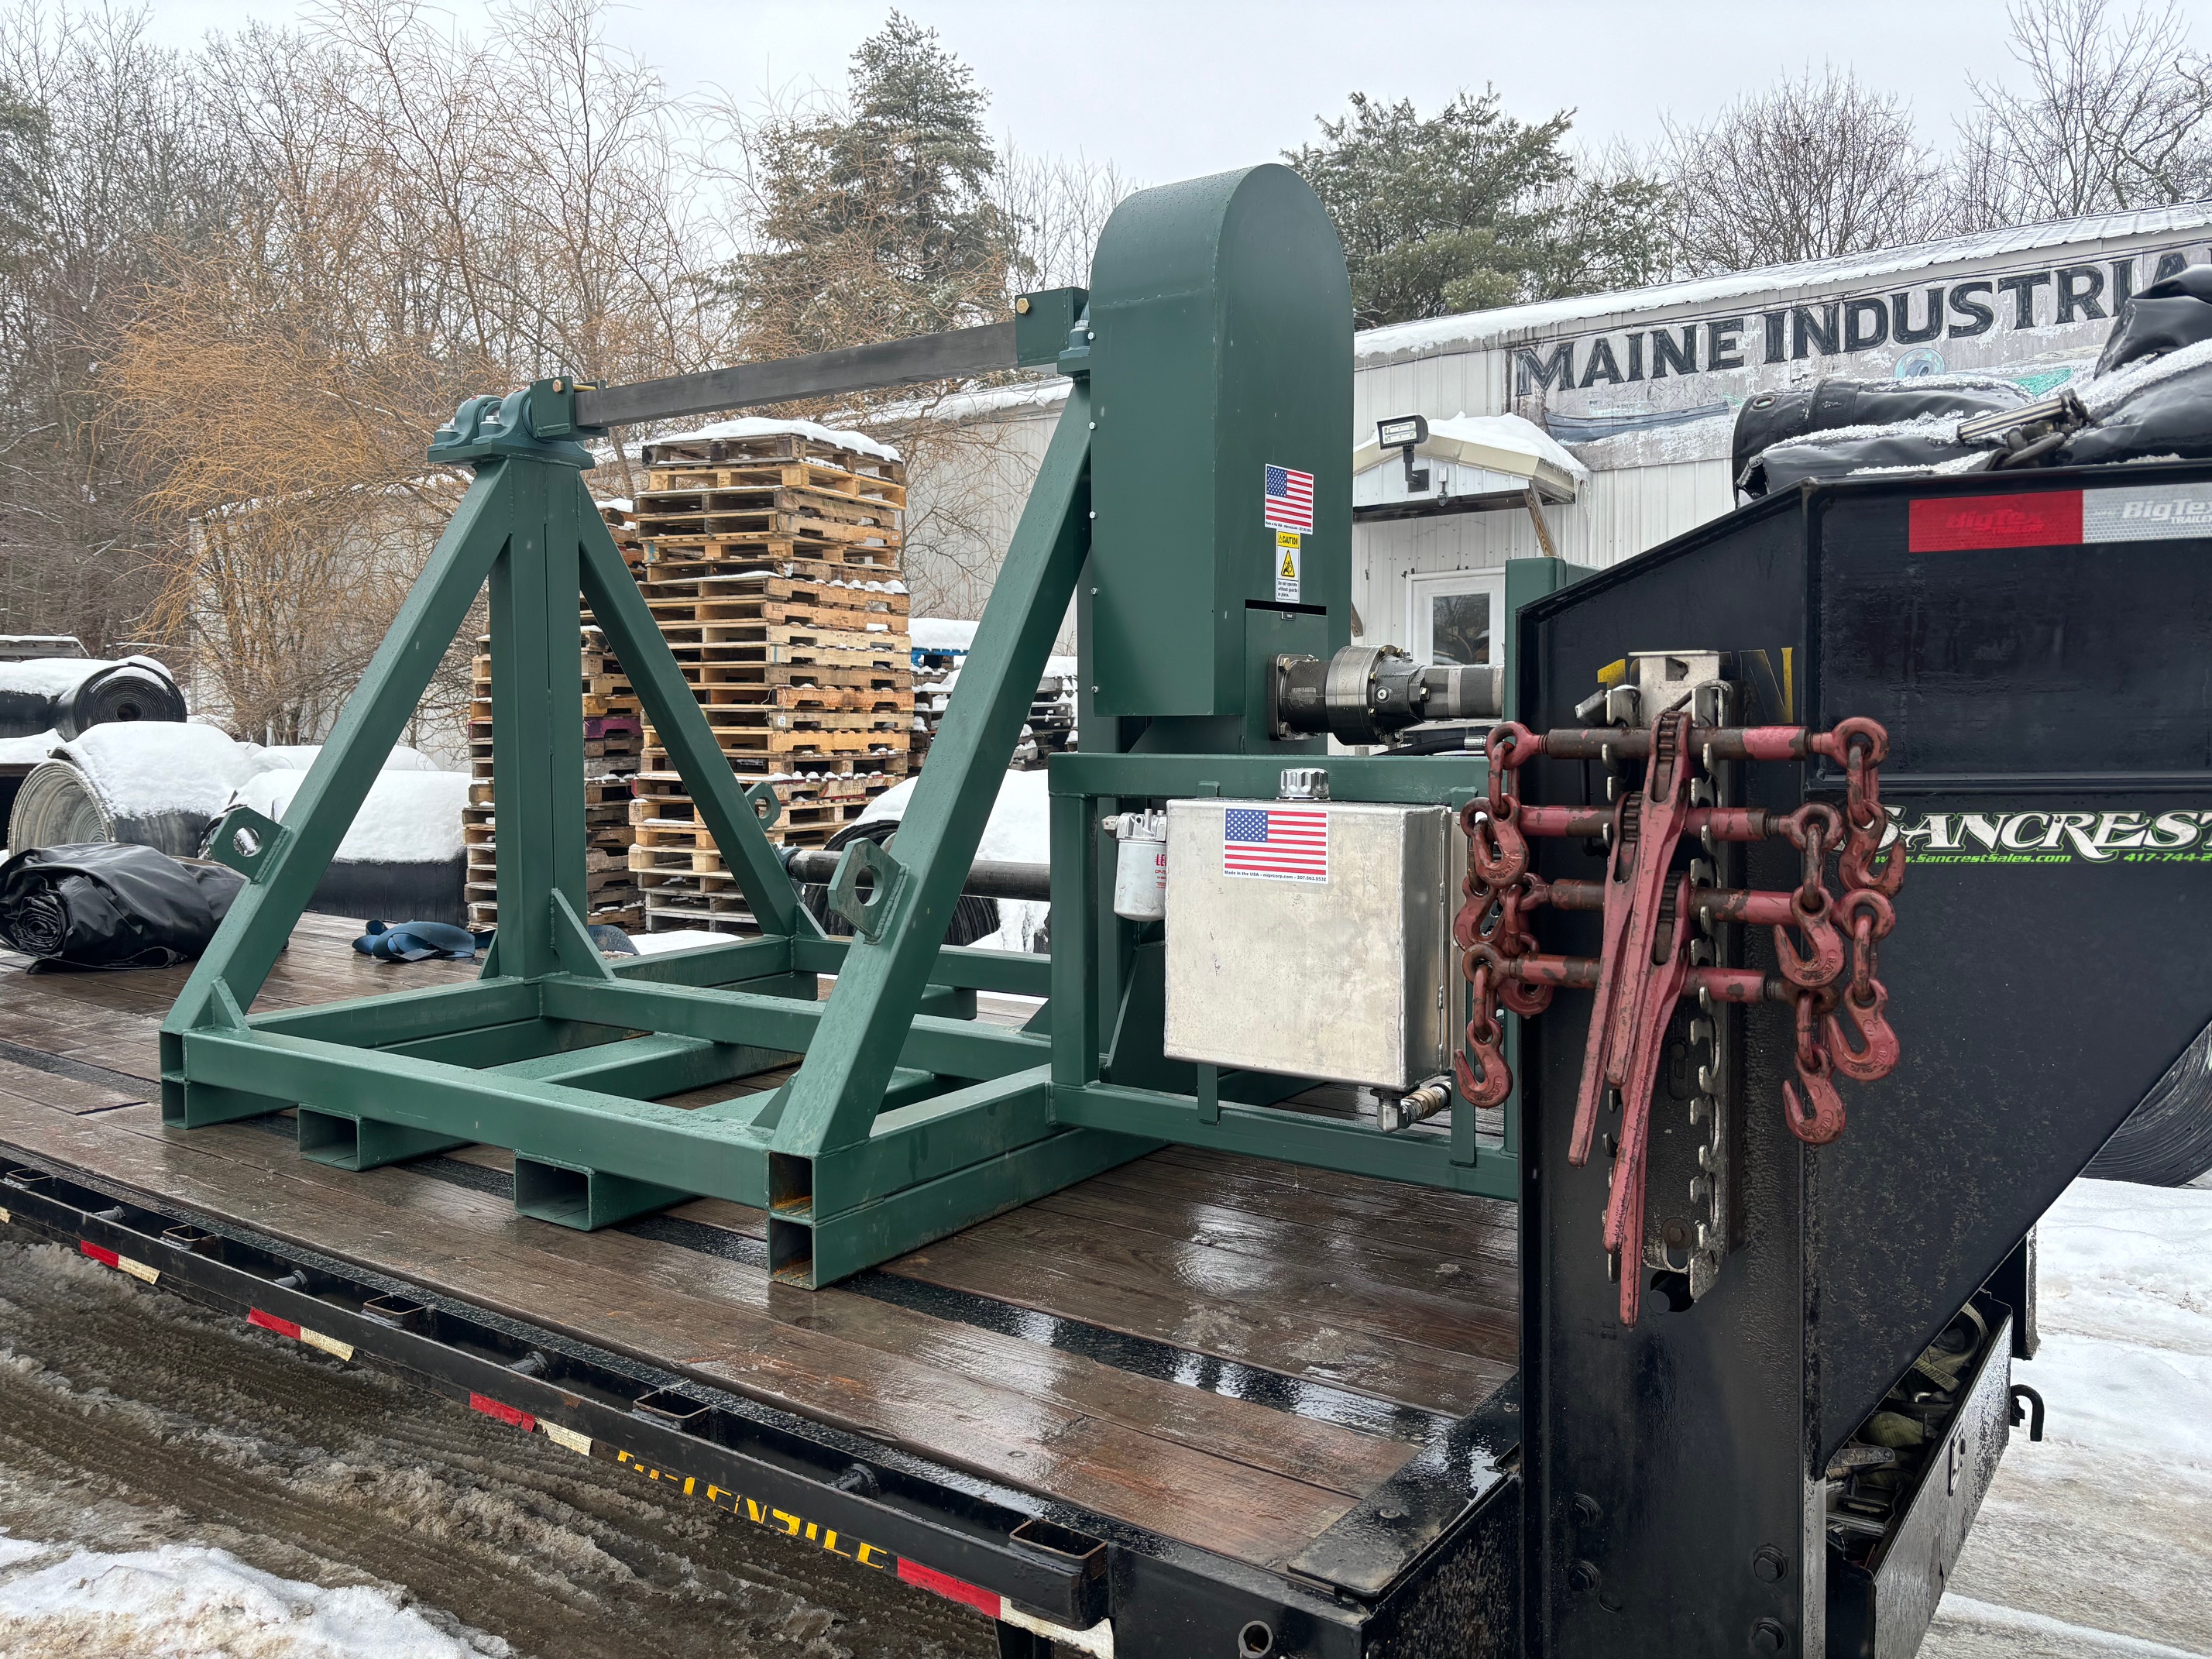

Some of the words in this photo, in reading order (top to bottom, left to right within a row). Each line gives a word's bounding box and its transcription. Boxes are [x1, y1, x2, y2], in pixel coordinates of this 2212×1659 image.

[1513, 319, 1745, 397] MAINE
[1764, 247, 2212, 364] INDUSTRI
[1283, 535, 1298, 545] CAUTION
[1832, 805, 2212, 861] SANCRES
[1875, 854, 2071, 864] ww.SancrestSales.com
